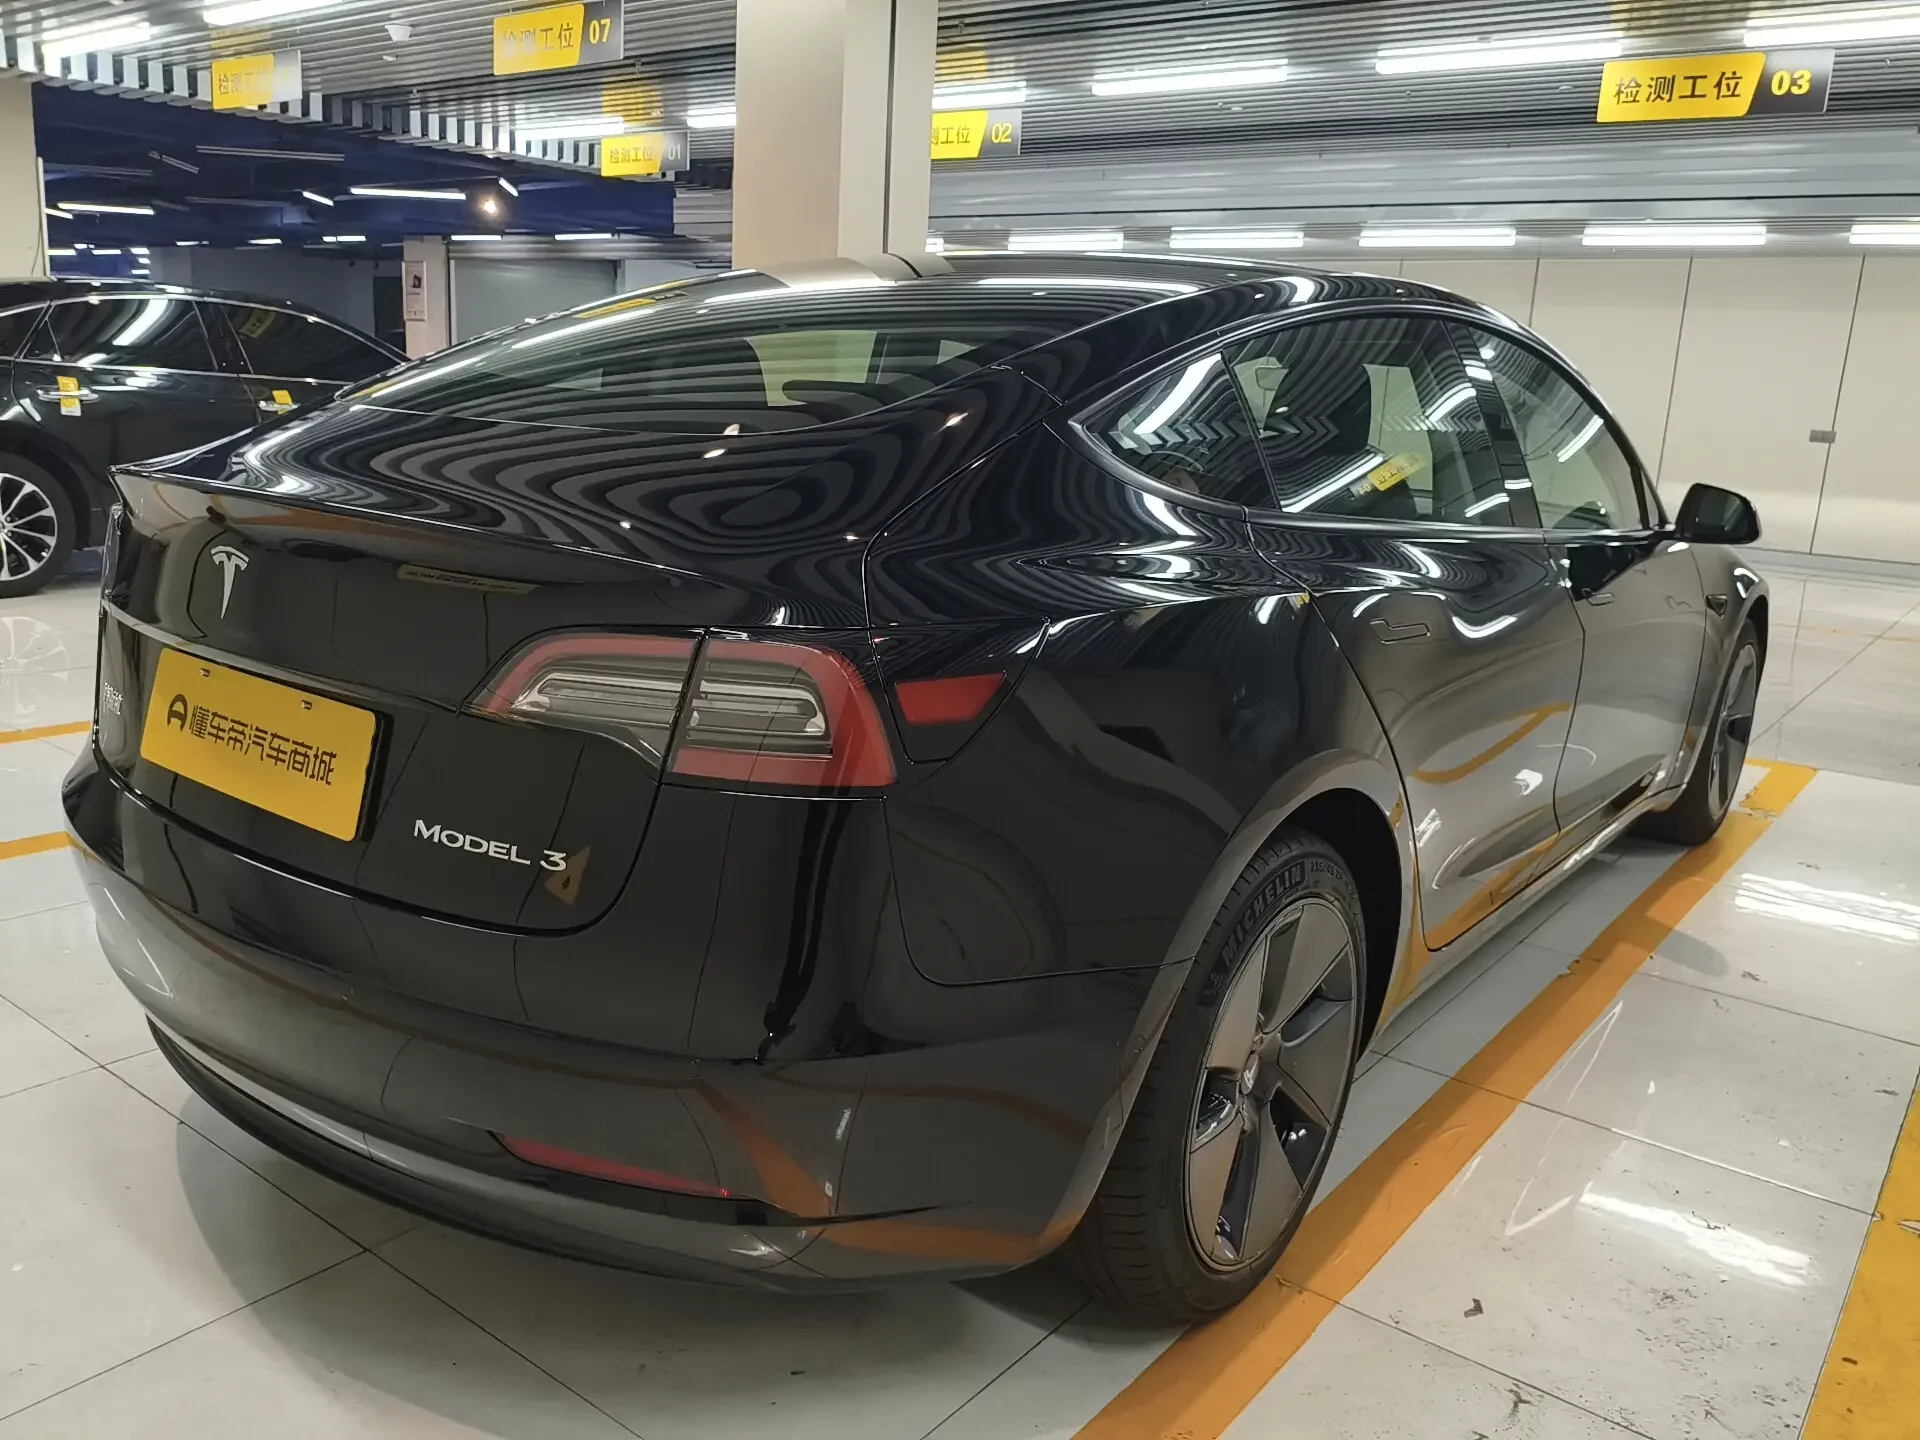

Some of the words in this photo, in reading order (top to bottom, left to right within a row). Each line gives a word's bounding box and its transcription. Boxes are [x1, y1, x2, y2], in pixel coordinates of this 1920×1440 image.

[589, 18, 611, 44] 07
[217, 68, 271, 96] 检测工
[1614, 70, 1743, 105] 检测工位
[1771, 69, 1812, 96] 03
[991, 122, 1012, 143] 02
[668, 143, 681, 160] 01
[414, 819, 531, 865] MODEL
[540, 849, 567, 871] 3
[1221, 864, 1301, 966] MICHELIN
